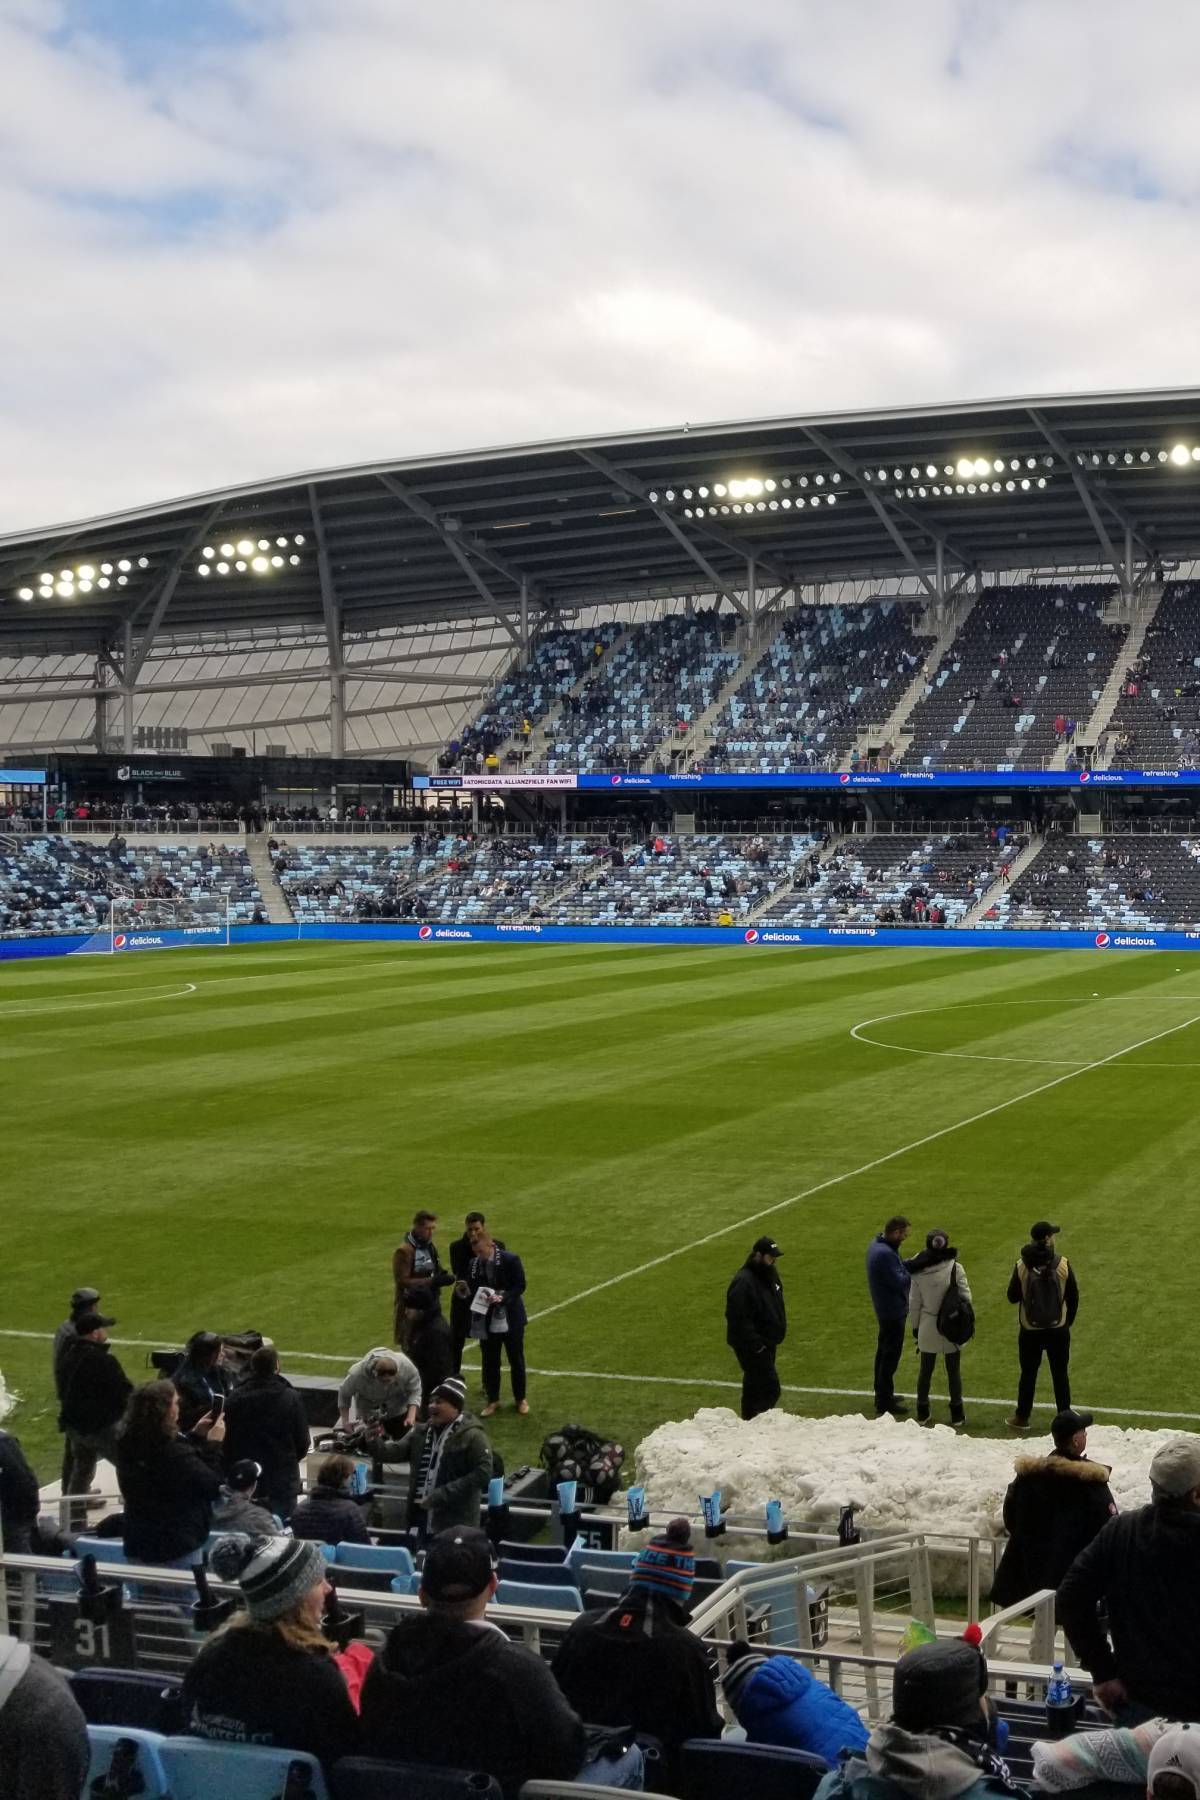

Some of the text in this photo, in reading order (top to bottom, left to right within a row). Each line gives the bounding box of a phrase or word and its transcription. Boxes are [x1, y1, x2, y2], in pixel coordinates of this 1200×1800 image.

[900, 772, 935, 780] refreshing.
[1143, 770, 1180, 778] refreshing.
[435, 930, 472, 938] delicious.
[762, 933, 802, 941] delicious.
[130, 937, 163, 945] delicious.
[1114, 937, 1157, 946] delicious.
[74, 1618, 110, 1658] 31
